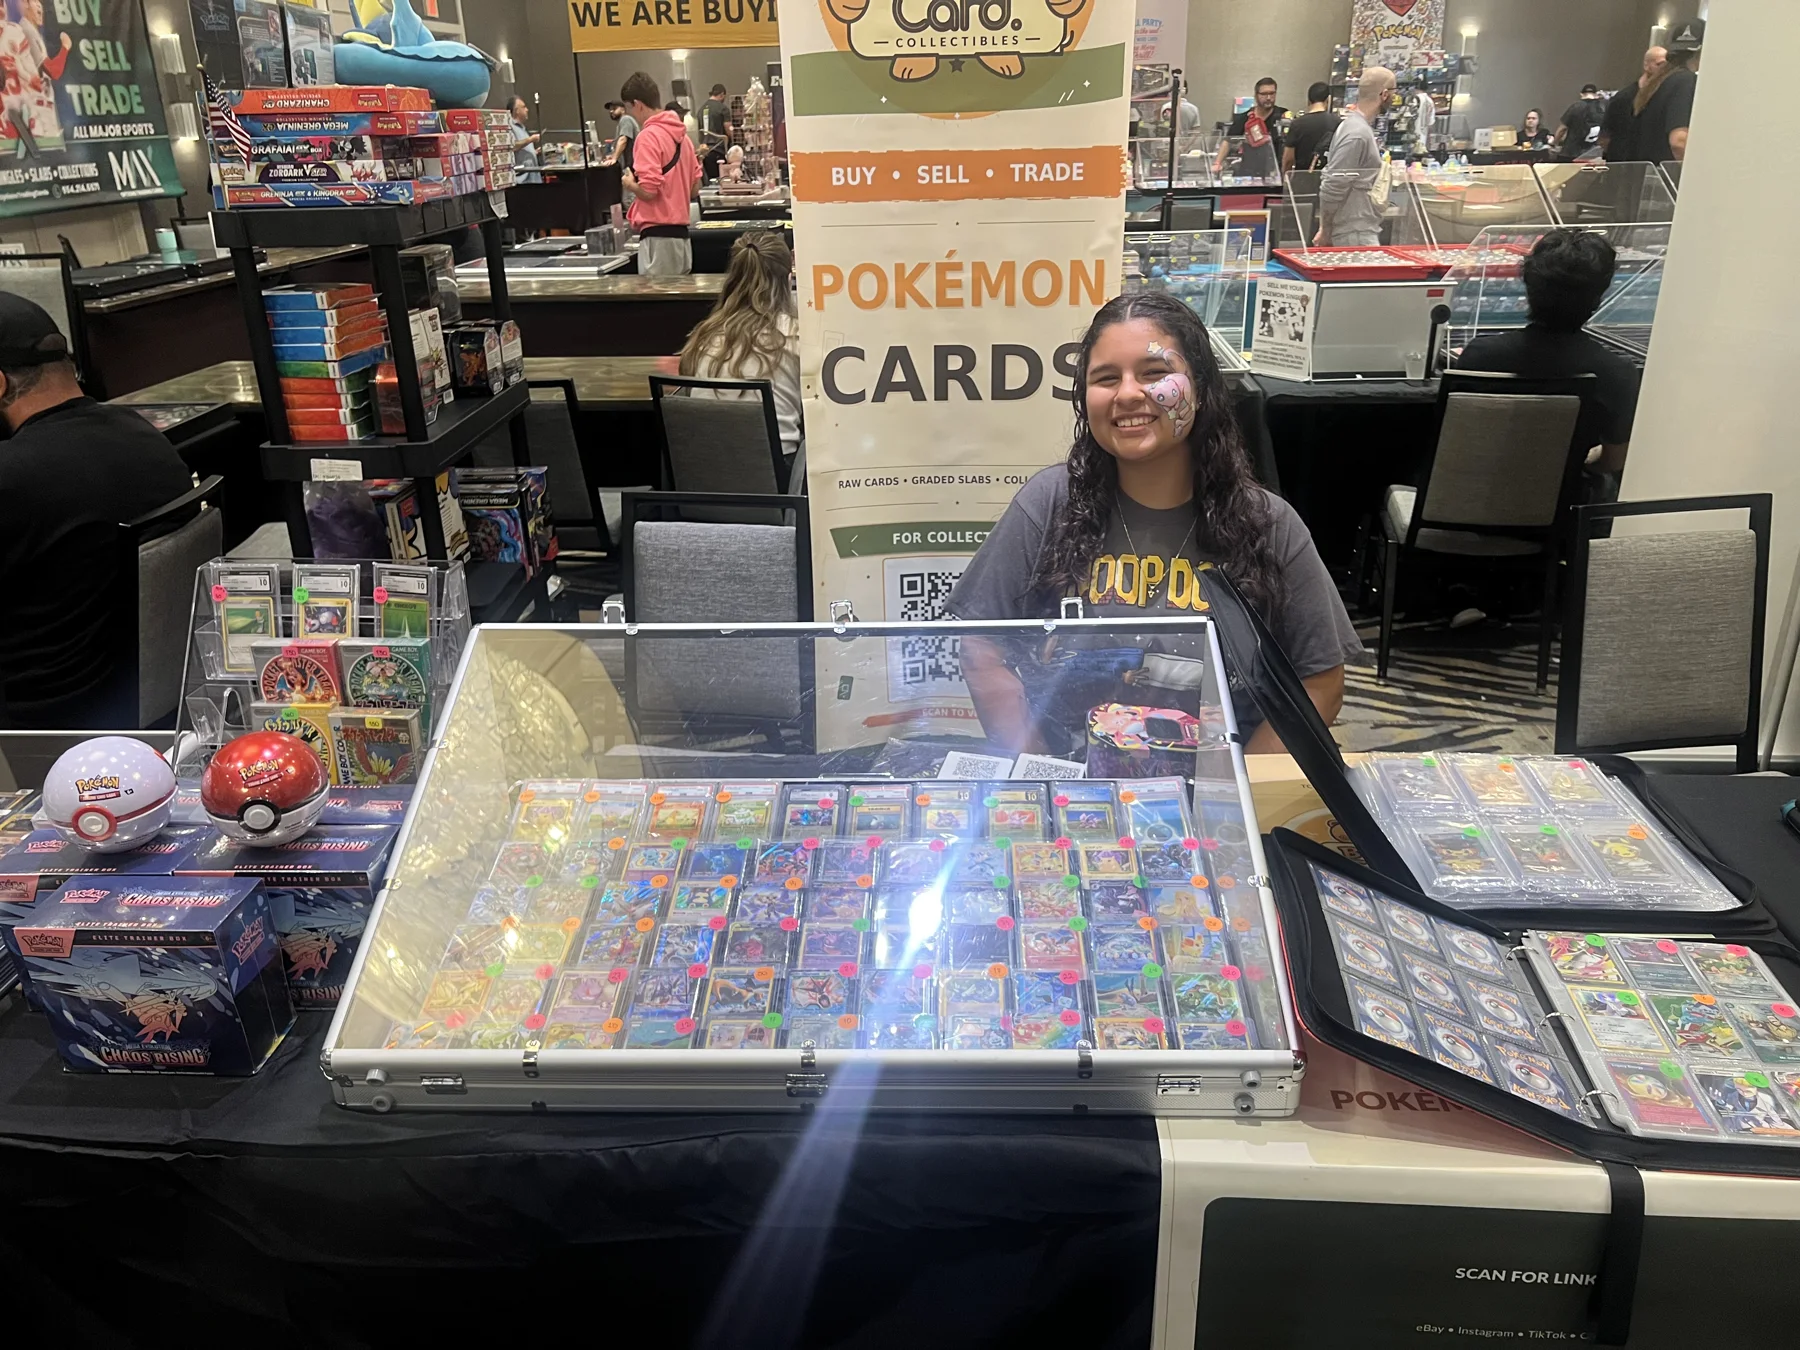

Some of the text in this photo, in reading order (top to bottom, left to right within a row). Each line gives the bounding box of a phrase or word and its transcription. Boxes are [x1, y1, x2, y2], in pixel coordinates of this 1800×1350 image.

[53, 0, 101, 26] BUY
[572, 2, 621, 27] WE
[632, 1, 692, 26] ARE
[895, 35, 1019, 48] COLLECTIBLES
[79, 38, 131, 71] SELL
[65, 84, 145, 116] TRADE
[276, 99, 330, 108] CHARIZARD
[73, 123, 155, 139] ALL MAJOR SPORTS
[277, 122, 321, 131] GRENINJA
[321, 121, 349, 129] MEGA
[251, 144, 296, 155] GRAFAIAI
[269, 168, 304, 177] ZOROARK
[831, 162, 1084, 187] BUY SELL TRADE
[260, 190, 294, 198] GRENINJA
[811, 249, 1106, 311] POKÉMON
[1259, 290, 1285, 298] POKEMON
[838, 479, 861, 489] RAW
[865, 477, 899, 487] CARDS
[911, 476, 955, 485] GRADED
[958, 475, 991, 485] SLABS
[892, 533, 922, 545] FOR
[259, 578, 268, 587] 10
[340, 580, 349, 588] 10
[416, 582, 425, 590] 10
[922, 707, 948, 717] SCAN
[951, 708, 964, 717] TO
[338, 753, 349, 767] BOY
[959, 791, 969, 800] 10
[1026, 791, 1037, 801] 10
[320, 840, 368, 850] RISING
[124, 893, 224, 907] CHAOS RISING
[101, 1046, 205, 1065] CHAOS RISING
[1455, 1267, 1597, 1286] SCAN FOR LINK
[1416, 1324, 1445, 1334] eBay
[1458, 1326, 1514, 1338] Instagram
[1528, 1330, 1566, 1339] TikTok
